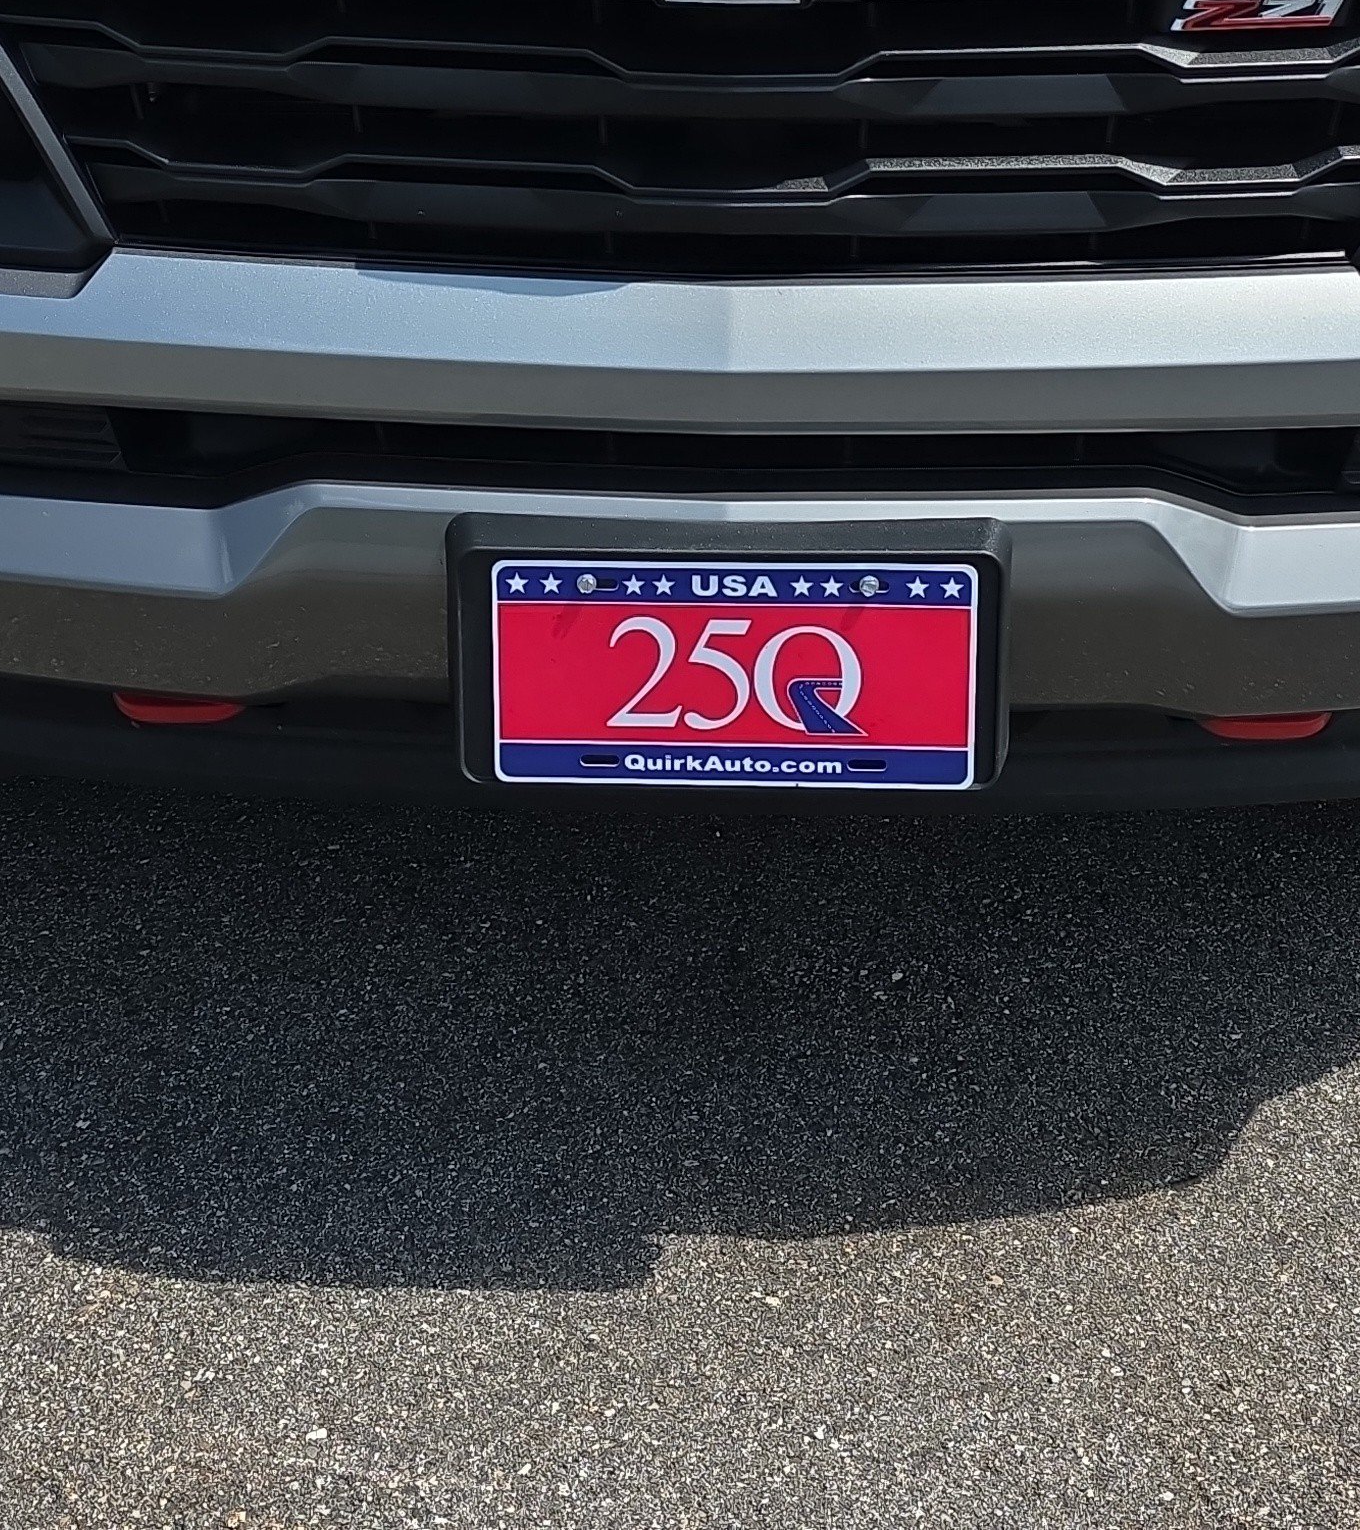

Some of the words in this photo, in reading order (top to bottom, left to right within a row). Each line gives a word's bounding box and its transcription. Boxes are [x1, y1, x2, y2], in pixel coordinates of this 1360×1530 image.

[690, 574, 778, 598] USA
[605, 616, 869, 737] 25Q
[623, 753, 843, 774] QuirkAuto.com
